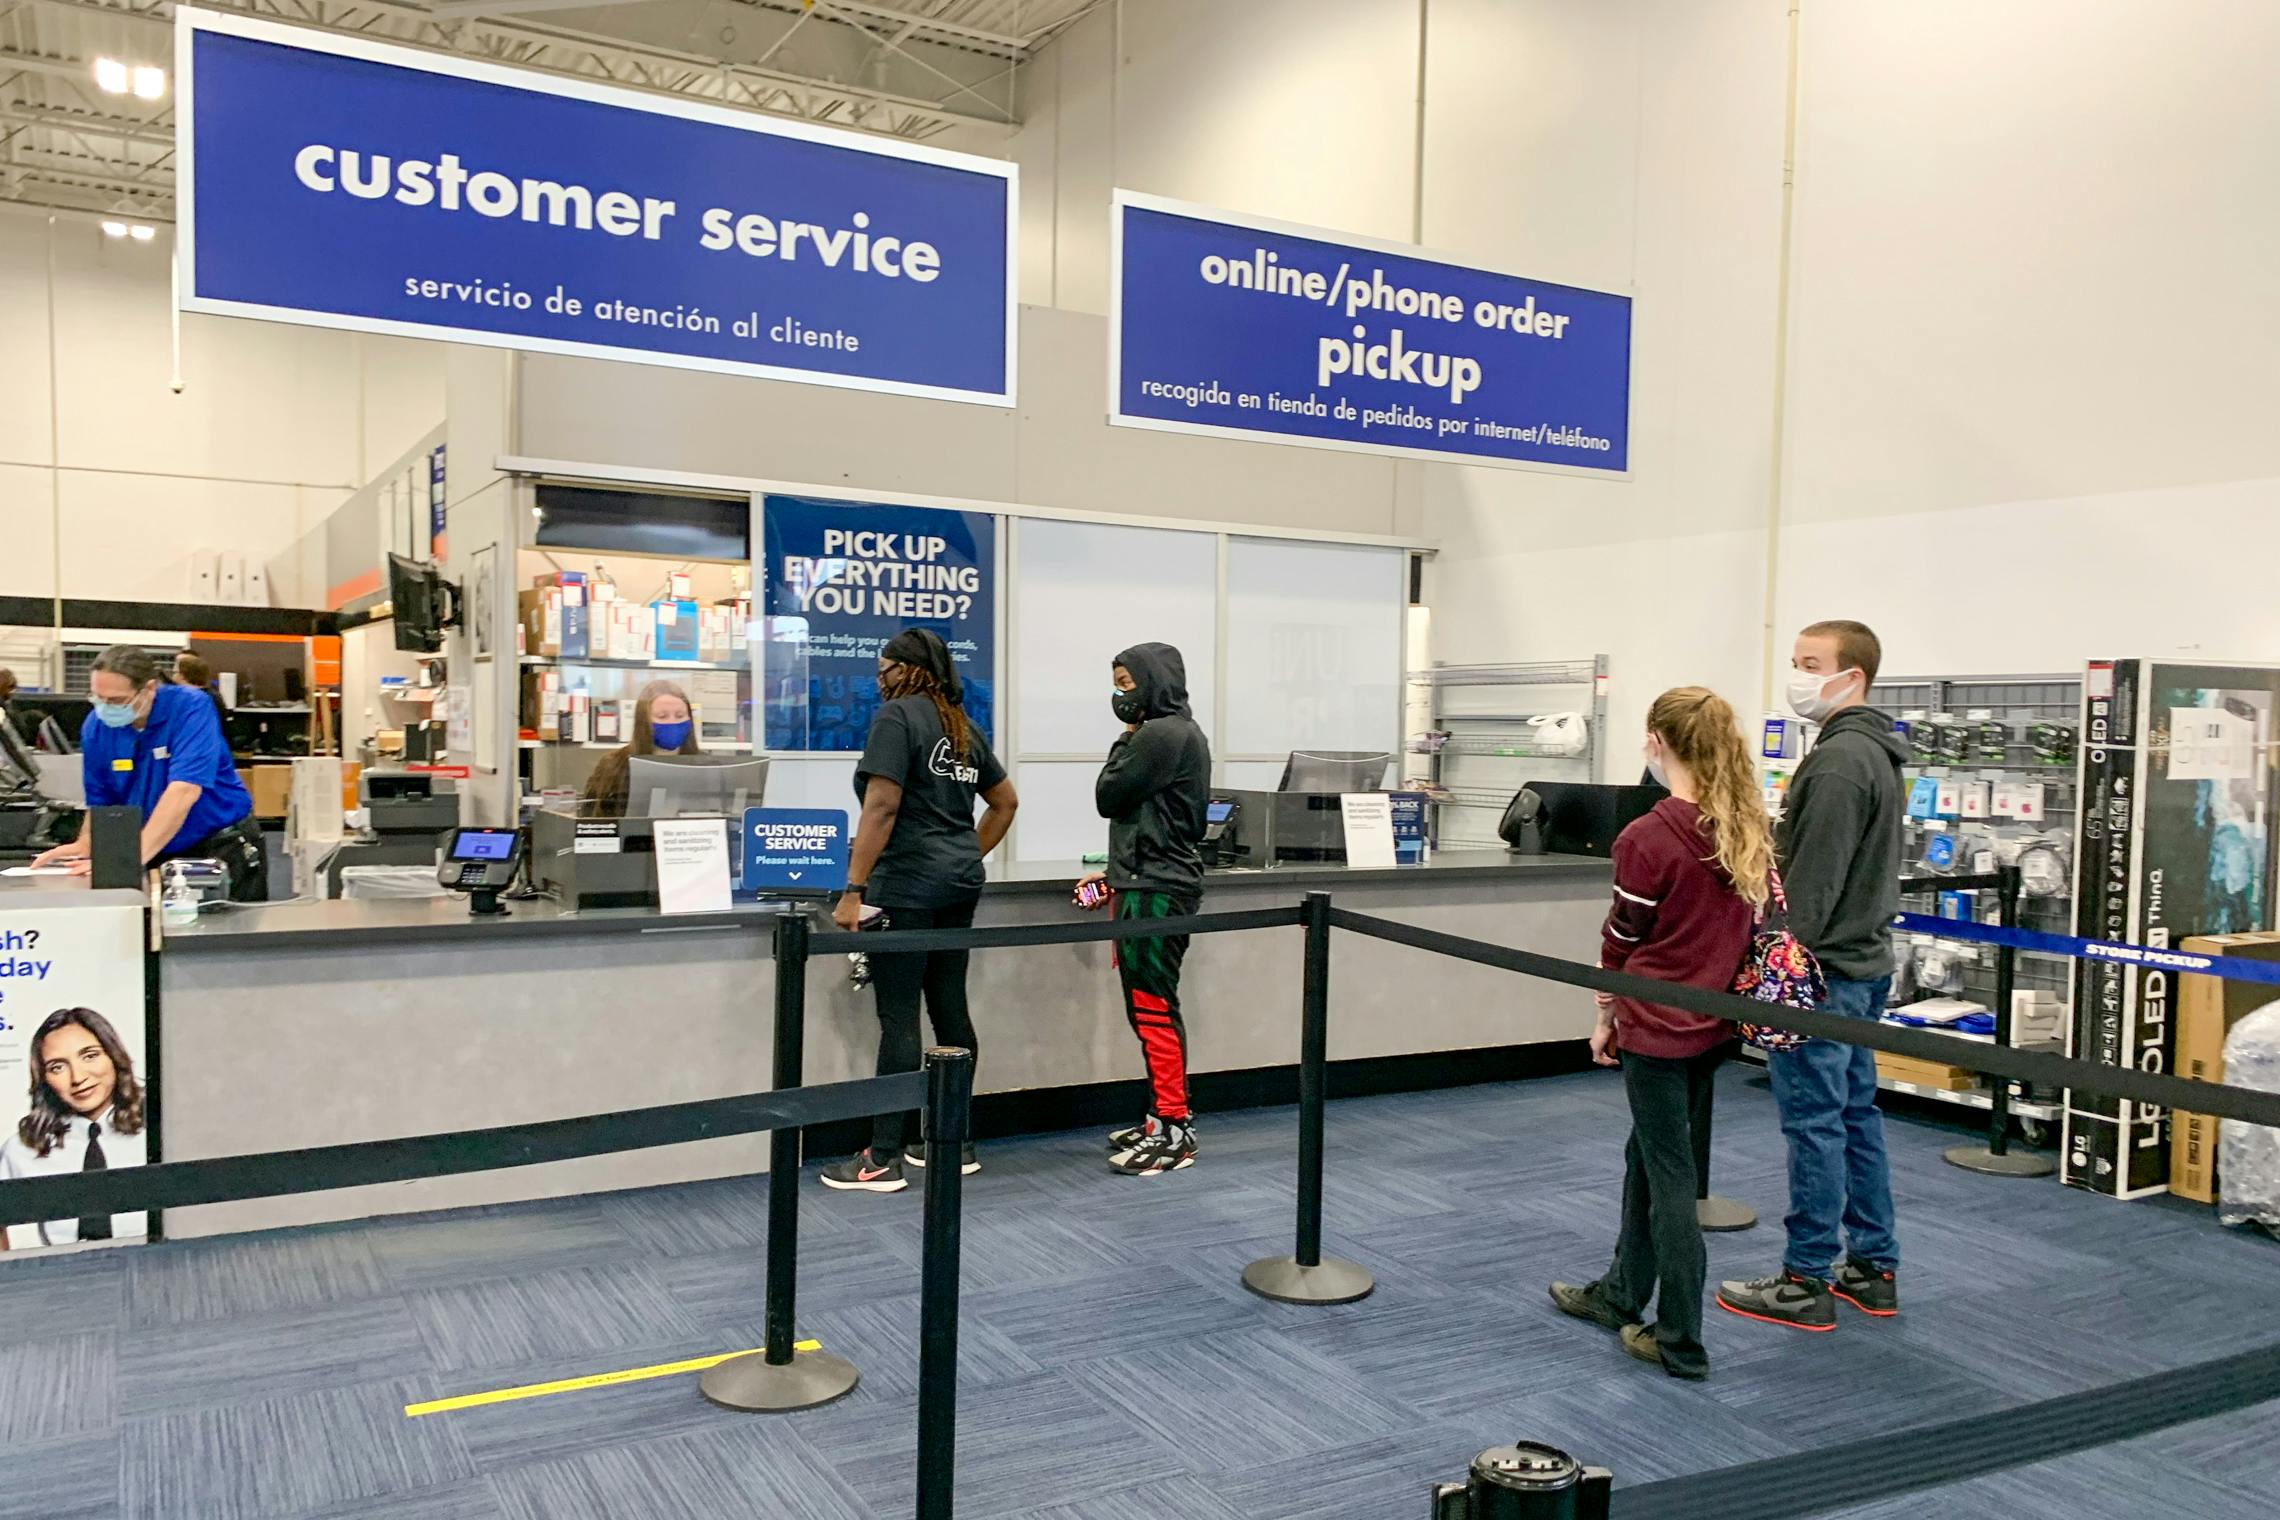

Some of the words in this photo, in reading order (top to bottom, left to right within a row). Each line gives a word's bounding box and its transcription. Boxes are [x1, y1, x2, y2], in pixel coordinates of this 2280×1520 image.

[295, 145, 676, 241] customer
[700, 209, 942, 284] service
[1200, 248, 1464, 323] online/phone
[1474, 296, 1570, 339] order
[405, 279, 532, 310] servicio
[545, 286, 583, 316] de
[594, 300, 720, 334] atención
[733, 312, 759, 339] al
[771, 317, 860, 352] cliente
[1319, 325, 1482, 404] pickup
[1141, 380, 1232, 408] recogida
[1238, 393, 1262, 409] en
[1268, 392, 1328, 417] tienda
[1334, 397, 1358, 421] de
[1363, 404, 1433, 430] pedidos
[1439, 418, 1469, 437] por
[1474, 417, 1611, 451] internet/teléfono
[824, 529, 899, 559] PICK
[904, 535, 946, 562] UP
[784, 556, 980, 593] EVERYTHING
[797, 587, 866, 615] YOU
[873, 590, 972, 620] NEED?
[809, 635, 829, 644] can
[829, 633, 856, 648] help
[857, 637, 880, 648] you
[833, 647, 856, 658] and
[857, 647, 877, 658] the
[2090, 718, 2108, 764] OLED
[754, 823, 838, 838] CUSTOMER
[765, 837, 827, 850] SERVICE
[755, 855, 788, 865] Please
[788, 855, 810, 865] wait
[810, 855, 836, 865] here.
[2147, 868, 2164, 925] ThinQ
[2085, 943, 2144, 961] STORE
[2143, 950, 2212, 969] PICKUP
[2141, 970, 2167, 1074] OLED
[2073, 1135, 2086, 1152] LG
[2138, 1103, 2161, 1149] LG
